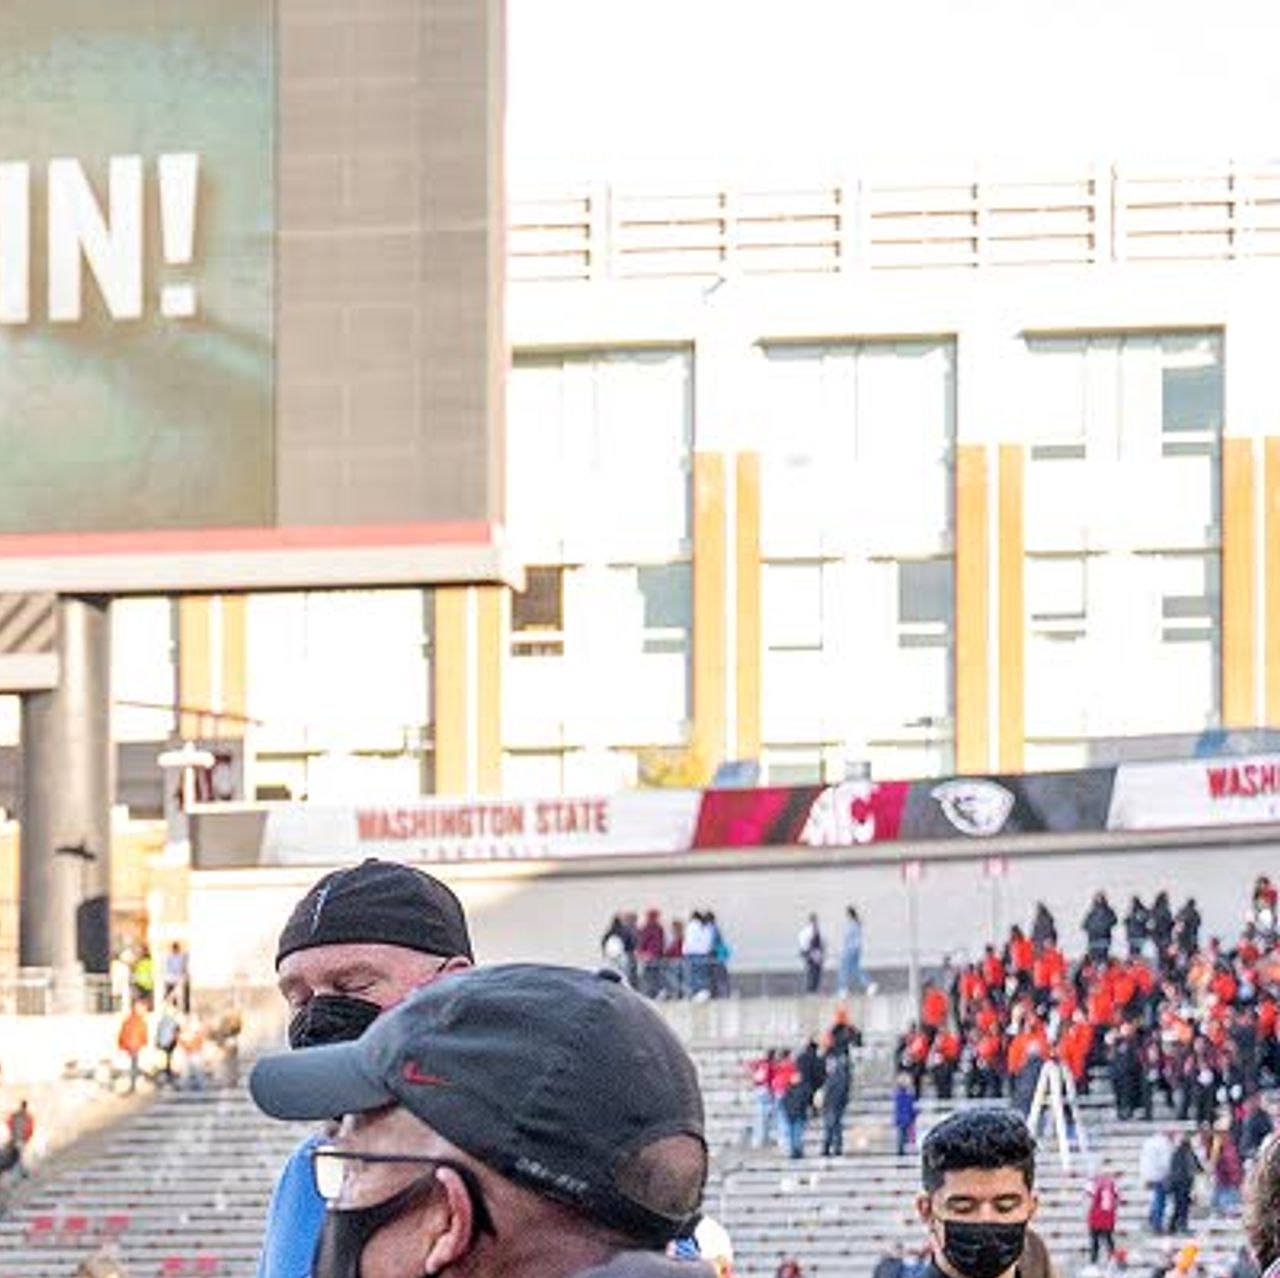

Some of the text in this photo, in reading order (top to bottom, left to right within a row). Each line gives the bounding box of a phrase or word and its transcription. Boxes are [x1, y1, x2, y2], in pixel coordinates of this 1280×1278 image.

[1207, 764, 1280, 798] WASH
[357, 801, 609, 841] WASHINGTON STATE
